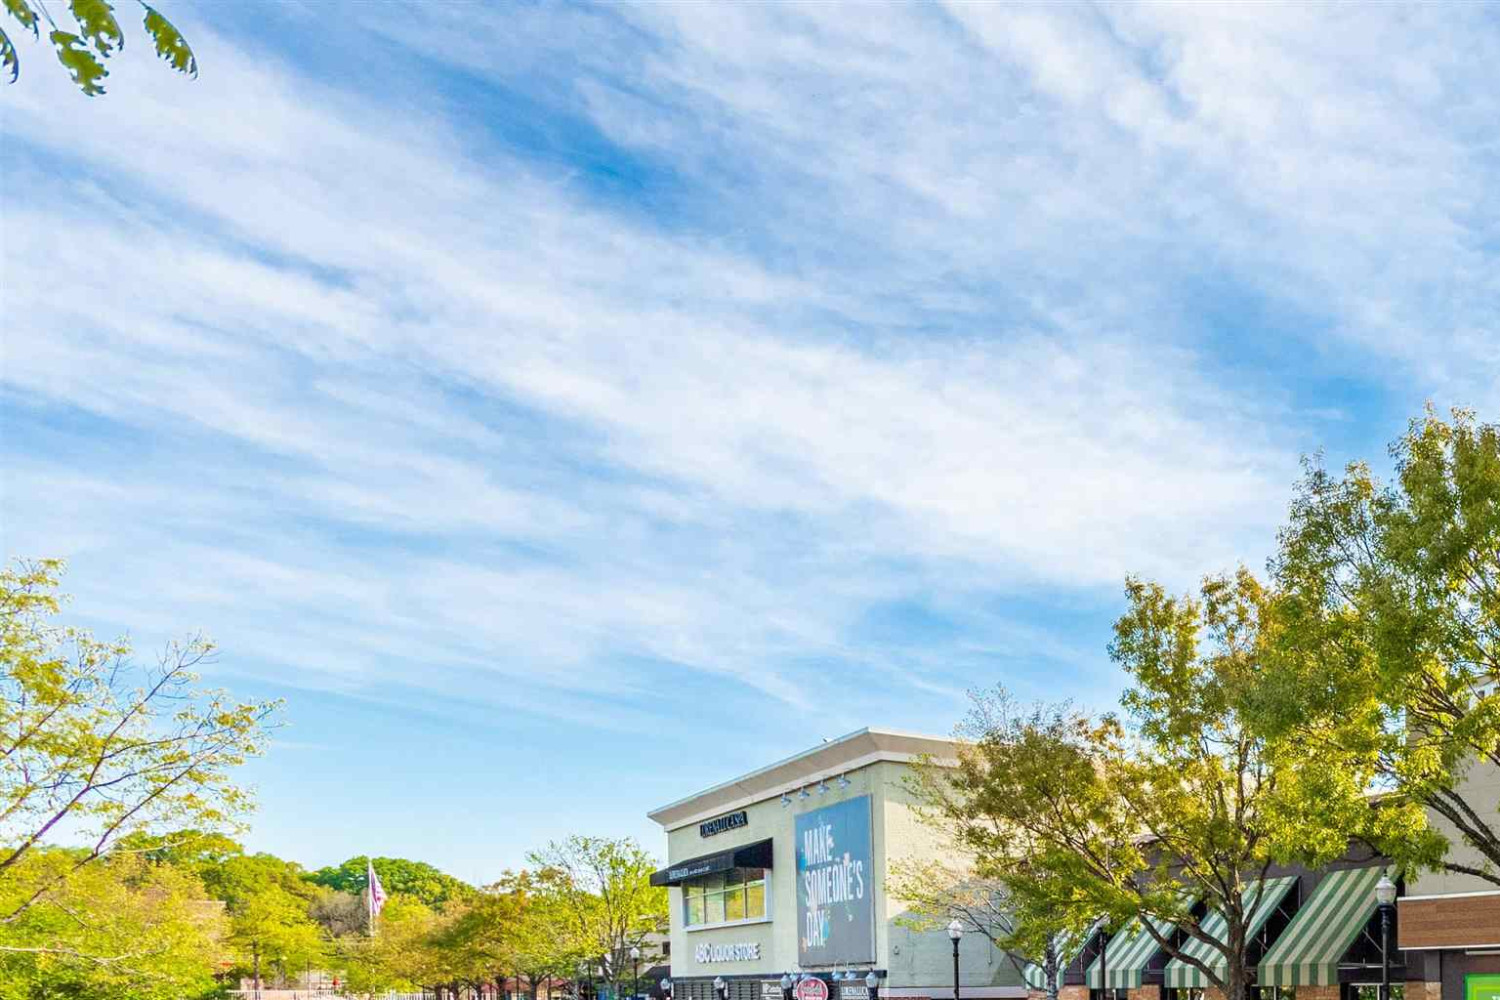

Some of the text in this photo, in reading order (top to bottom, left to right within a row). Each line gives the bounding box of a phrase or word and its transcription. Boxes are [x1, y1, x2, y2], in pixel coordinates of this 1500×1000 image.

[804, 824, 832, 866] MAKE
[805, 860, 864, 907] SOMEONE'S
[806, 909, 826, 947] DAY
